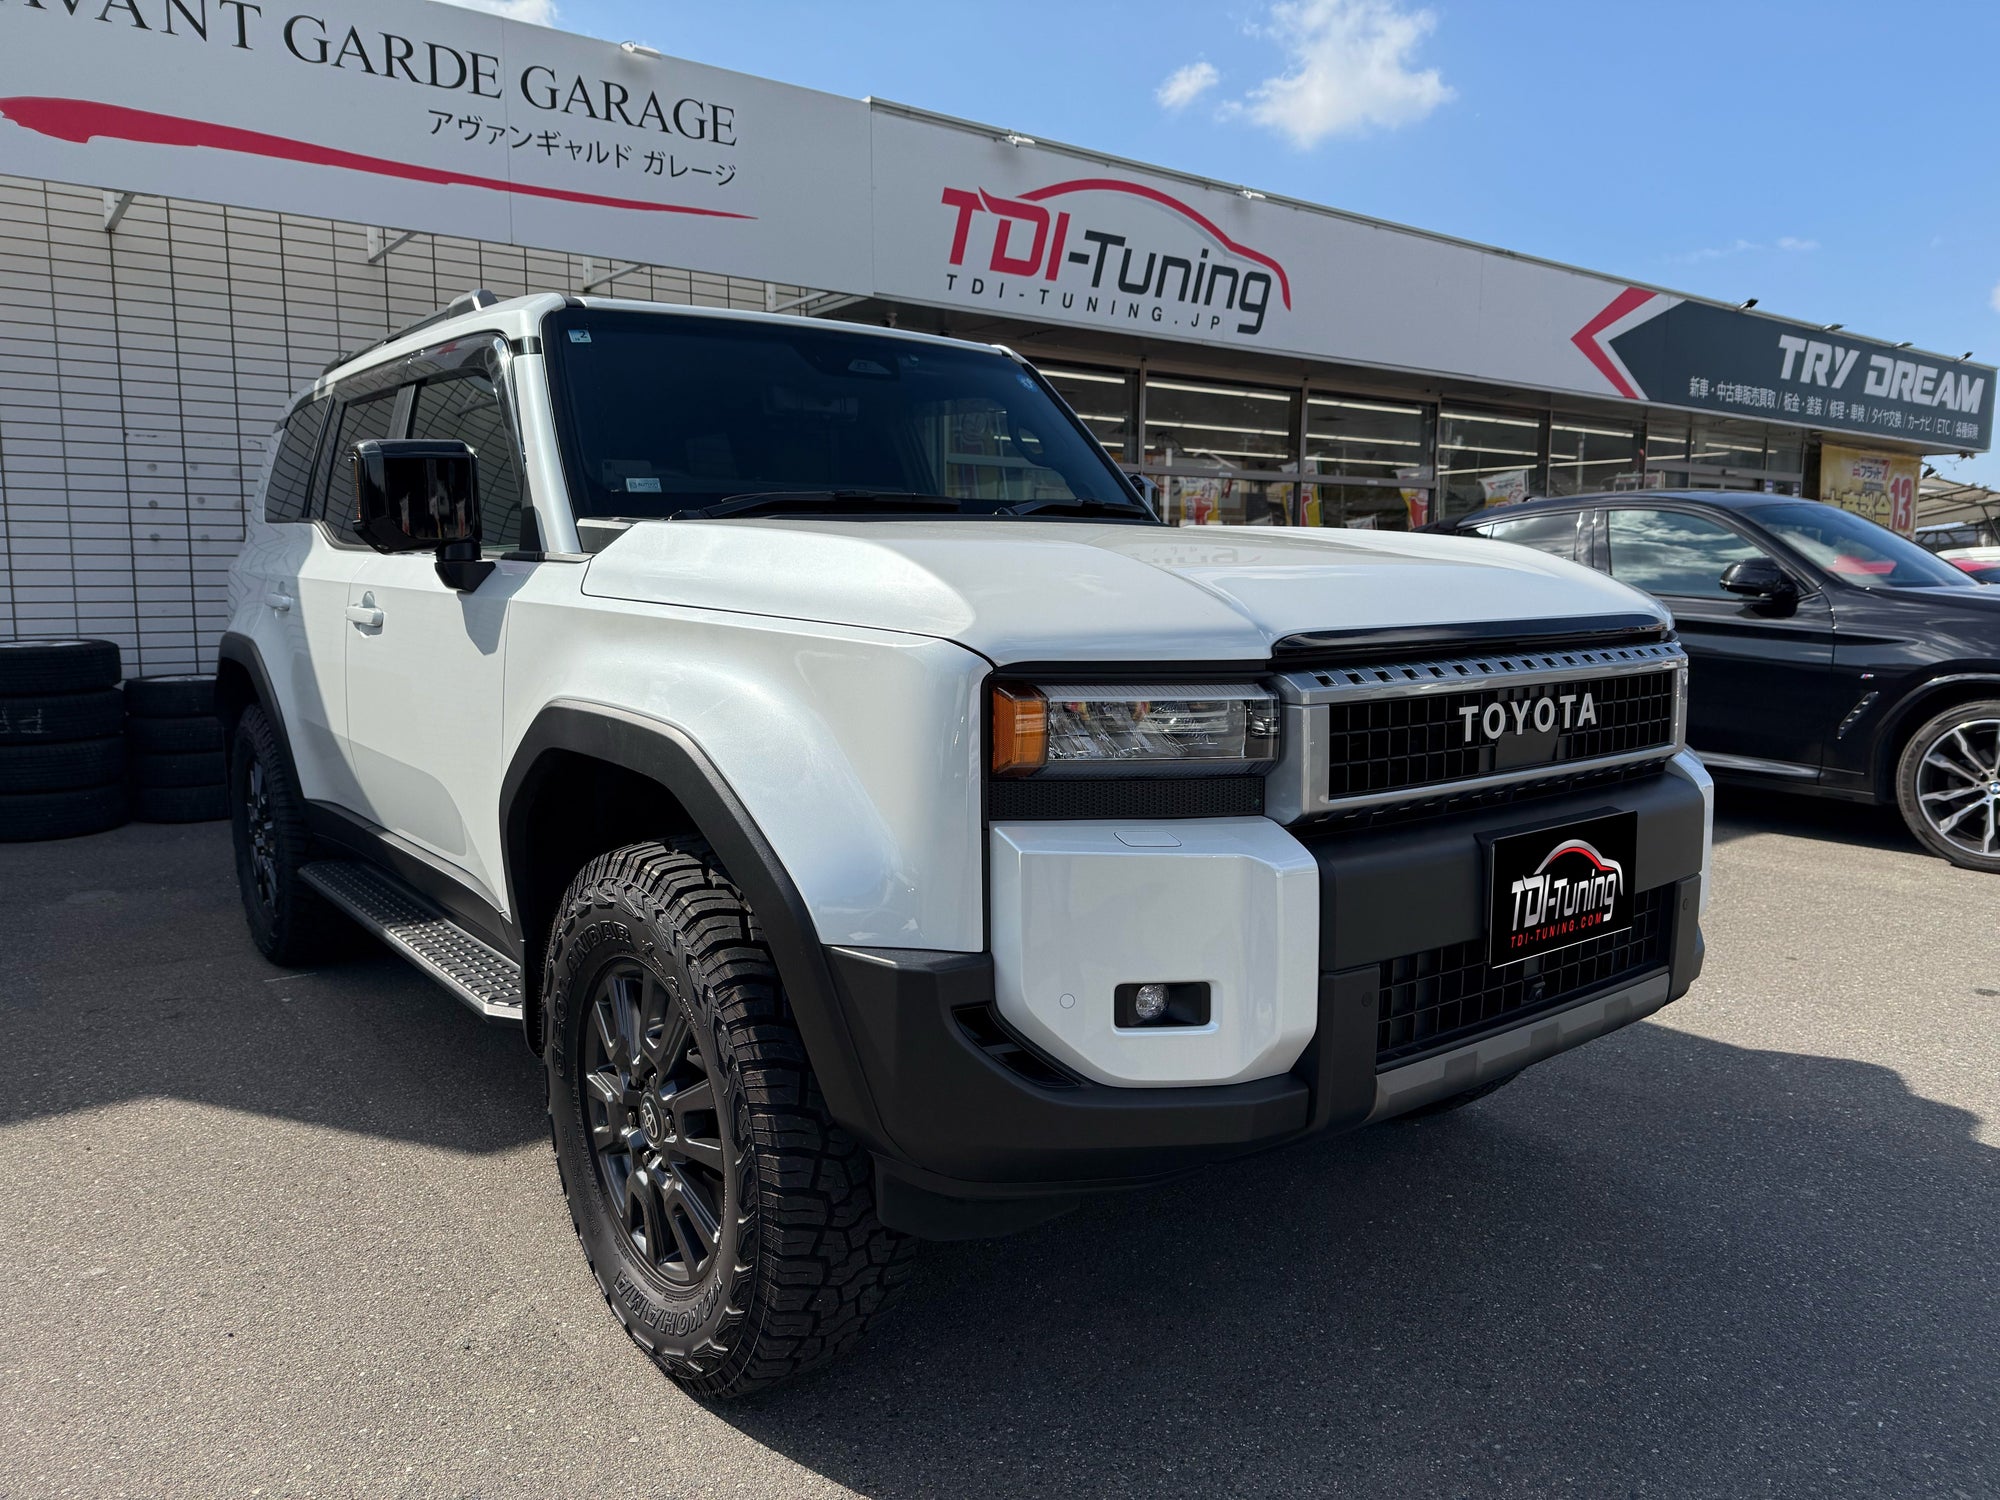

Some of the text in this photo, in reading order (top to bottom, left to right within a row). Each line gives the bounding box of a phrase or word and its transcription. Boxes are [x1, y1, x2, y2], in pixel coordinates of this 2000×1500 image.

[283, 14, 503, 99] GARDE
[520, 65, 738, 146] GARAGE
[428, 109, 737, 186] アヴァンギャルド ガレージ
[941, 186, 1272, 335] TDI-Tuning
[946, 273, 1221, 330] TDI-TUNING.JP
[1778, 334, 1985, 414] TRY DREAM
[1937, 418, 1950, 435] ETC
[1458, 692, 1597, 742] TOYOTA
[1511, 868, 1617, 932] TDI-Tuning
[1511, 912, 1603, 949] TDI-TUNING.COM
[613, 1267, 723, 1337] YOKOHAMA
